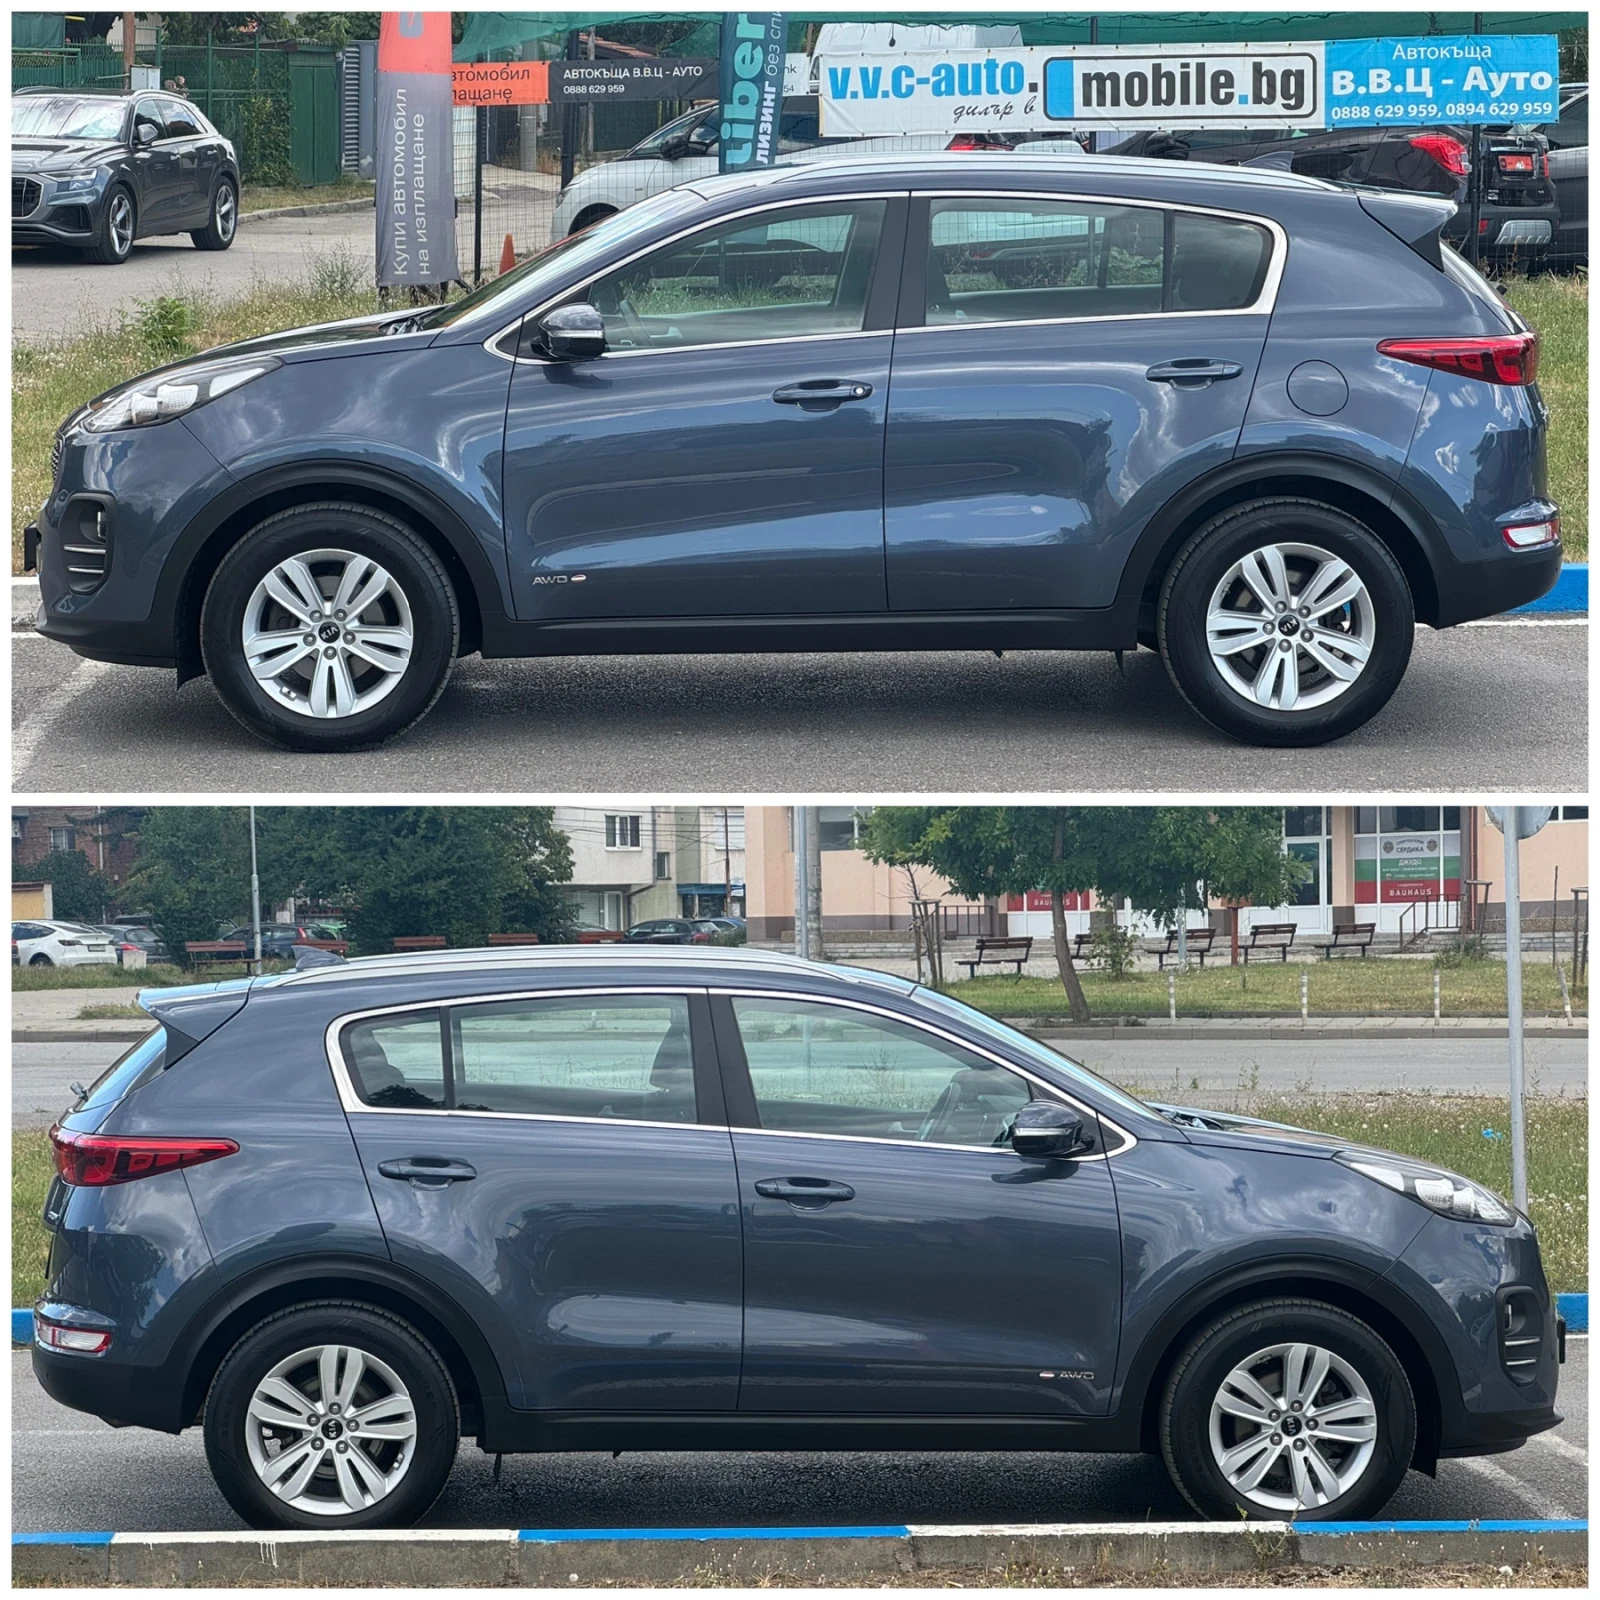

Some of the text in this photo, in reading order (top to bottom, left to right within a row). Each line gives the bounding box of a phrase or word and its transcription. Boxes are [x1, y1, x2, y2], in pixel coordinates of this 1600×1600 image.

[764, 44, 780, 76] без
[1392, 43, 1492, 61] Автокъща
[563, 68, 630, 79] АВТОКЪЩА
[633, 67, 663, 79] В.В.Ц
[672, 66, 703, 77] АУТО
[1332, 67, 1433, 98] В.В.Ц
[1462, 65, 1553, 98] Ауто
[563, 84, 625, 94] 0888 629 959
[1082, 61, 1305, 111] mobile.bg
[953, 100, 1014, 123] дилър
[1331, 102, 1552, 120] 0888 629 959, 0894 629 959
[756, 81, 777, 165] лизинг
[394, 89, 410, 275] Купи автомобил
[413, 113, 430, 275] на изплащане
[532, 575, 568, 585] AWD
[320, 626, 338, 640] KIA
[1280, 618, 1298, 632] KIA
[1396, 846, 1424, 854] СЕРДИКА
[1389, 888, 1432, 896] BAUHAUS
[1034, 898, 1071, 906] BAUS
[1058, 1371, 1094, 1380] AWD
[327, 1420, 337, 1438] KIA
[1286, 1417, 1297, 1436] KIA
